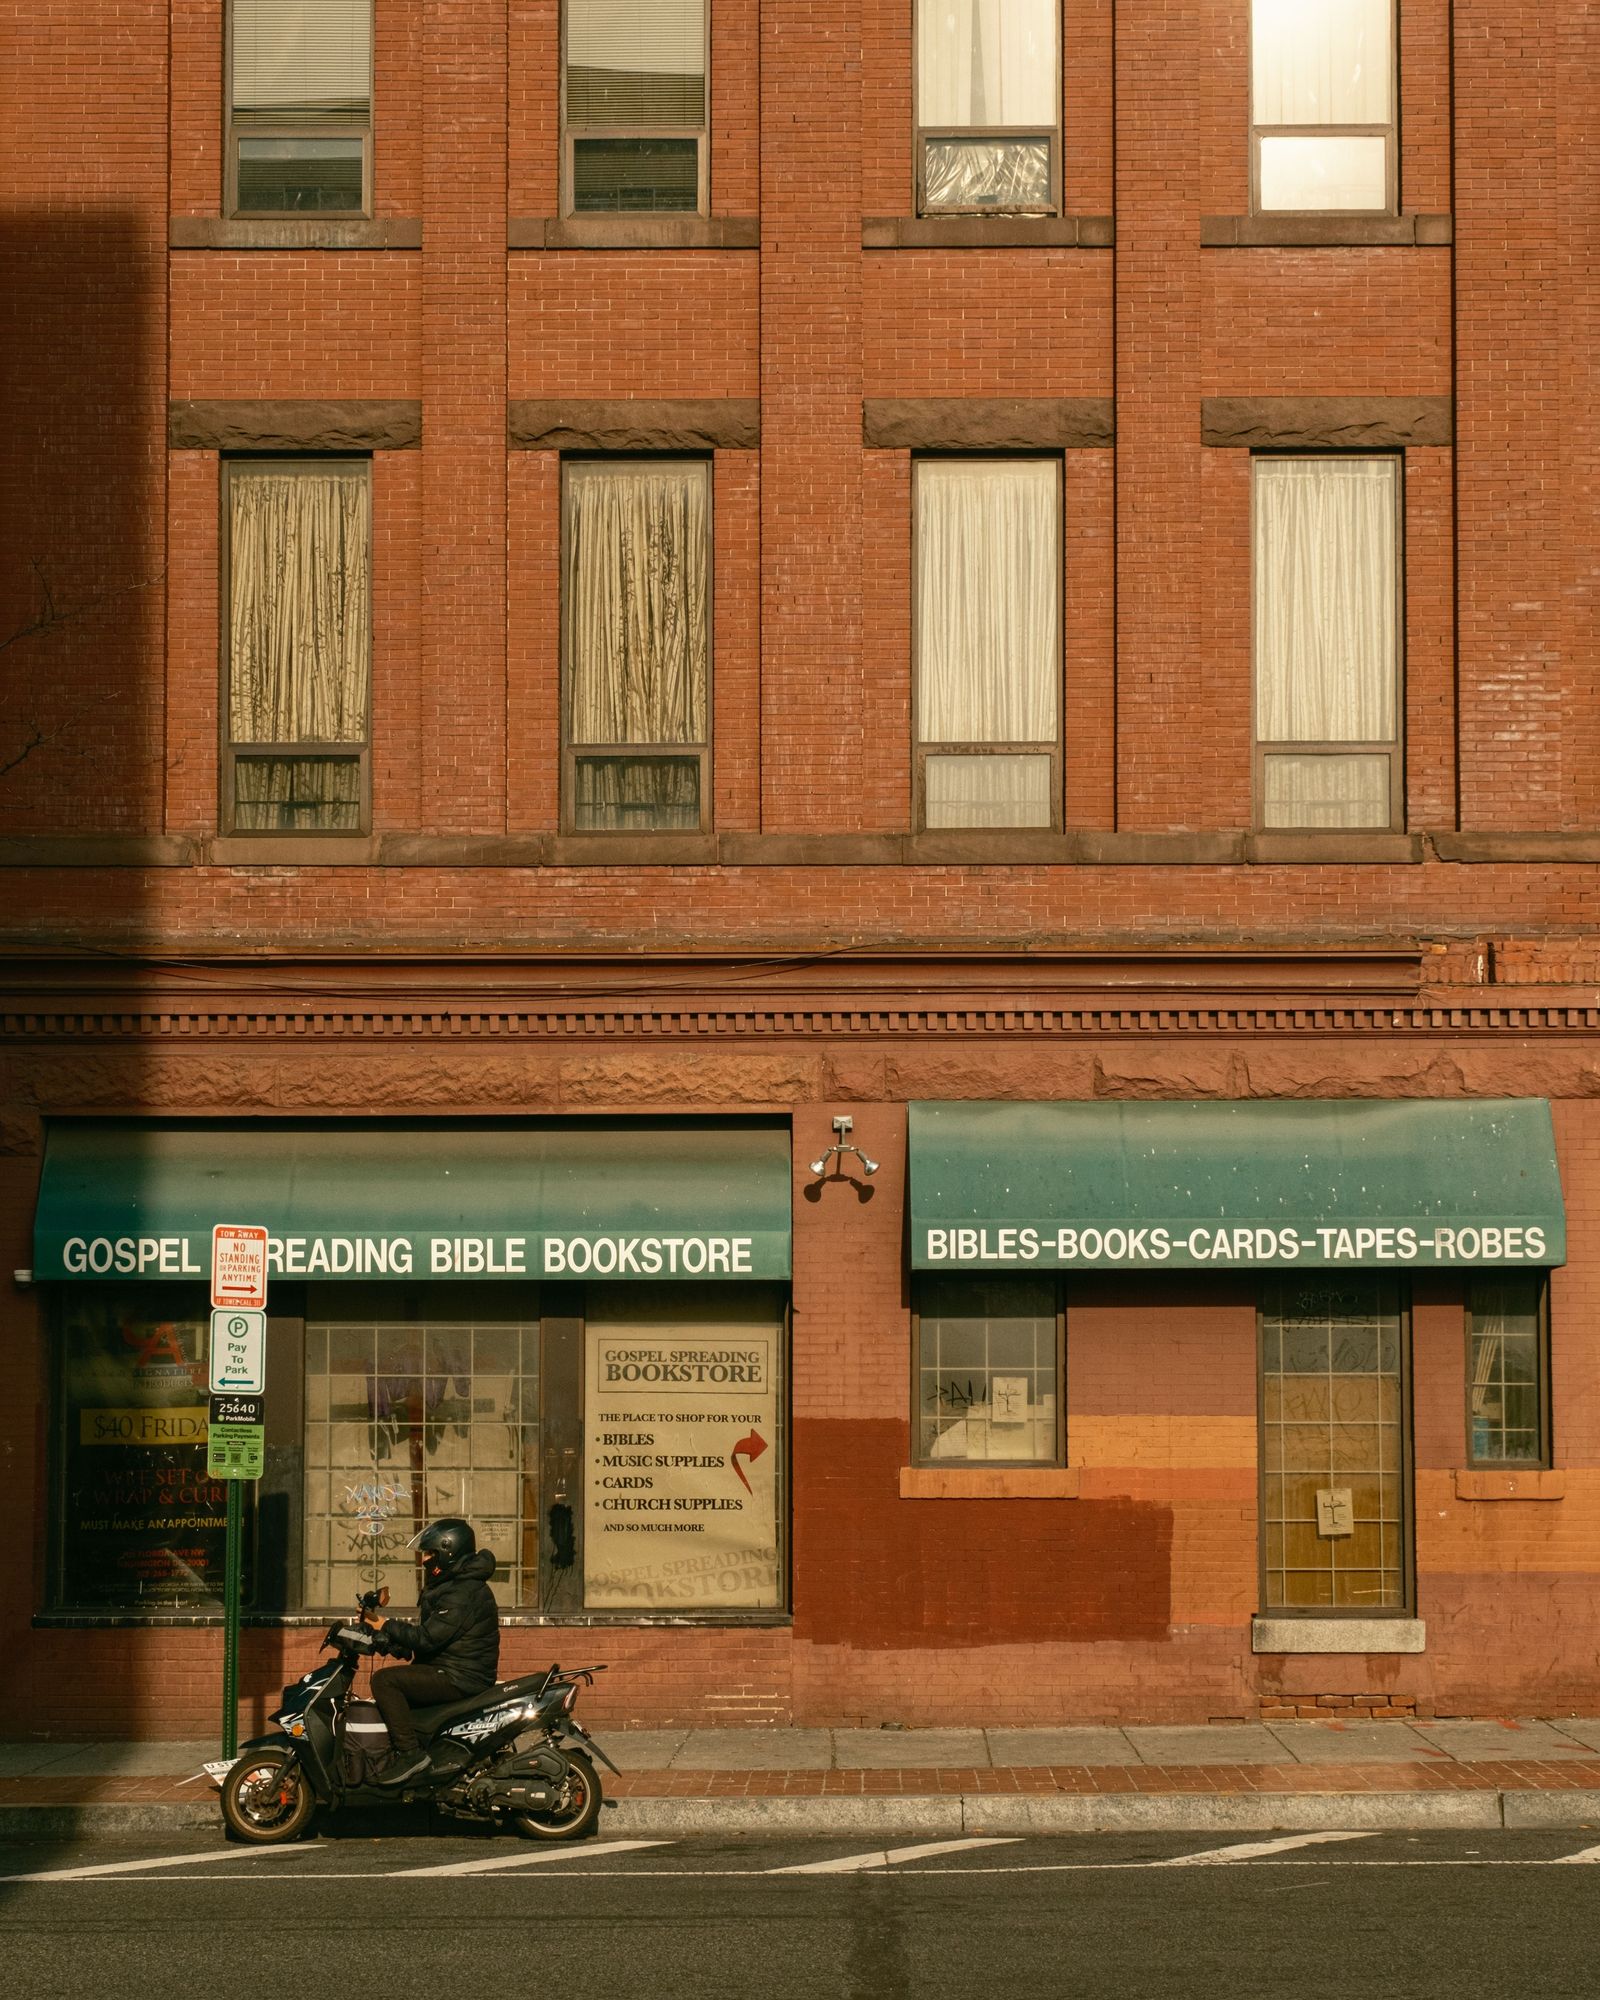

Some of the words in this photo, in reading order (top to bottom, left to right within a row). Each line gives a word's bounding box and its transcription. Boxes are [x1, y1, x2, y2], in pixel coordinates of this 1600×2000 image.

[237, 1230, 259, 1239] AWAY
[233, 1242, 246, 1252] NO
[63, 1237, 201, 1273] GOSPEL
[267, 1237, 413, 1273] READING
[431, 1238, 526, 1272] BIBLE
[545, 1237, 752, 1273] BOOKSTORE
[220, 1253, 260, 1264] STANDING
[227, 1264, 261, 1273] PARKING
[222, 1274, 257, 1282] ANYTIME
[228, 1343, 247, 1353] Pay
[232, 1355, 244, 1364] To
[605, 1350, 667, 1362] GOSPEL
[670, 1351, 760, 1364] SPREADING
[225, 1365, 248, 1374] Park
[606, 1363, 762, 1383] BOOKSTORE
[219, 1403, 255, 1414] 25640
[598, 1413, 620, 1422] THE
[622, 1413, 656, 1422] PLACE
[658, 1414, 674, 1422] TO
[675, 1414, 705, 1422] SHOP
[707, 1414, 729, 1423] FOR
[730, 1414, 762, 1423] YOUR
[94, 1415, 134, 1439] $40
[142, 1415, 208, 1438] FRIDA
[603, 1433, 655, 1446] BIBLES
[602, 1455, 652, 1467] MUSIC
[655, 1456, 724, 1468] SUPPLIES
[156, 1469, 193, 1487] SET
[602, 1476, 653, 1488] CARDS
[160, 1487, 176, 1504] &
[602, 1498, 672, 1510] CHURCH
[674, 1498, 743, 1511] SUPPLIES
[81, 1519, 110, 1530] MUST
[113, 1519, 145, 1530] MAKE
[147, 1518, 165, 1529] AN
[167, 1517, 248, 1529] APPOINTME!
[603, 1523, 625, 1532] AND
[626, 1523, 640, 1532] SO
[640, 1523, 673, 1532] MUCH
[673, 1524, 705, 1532] MORE
